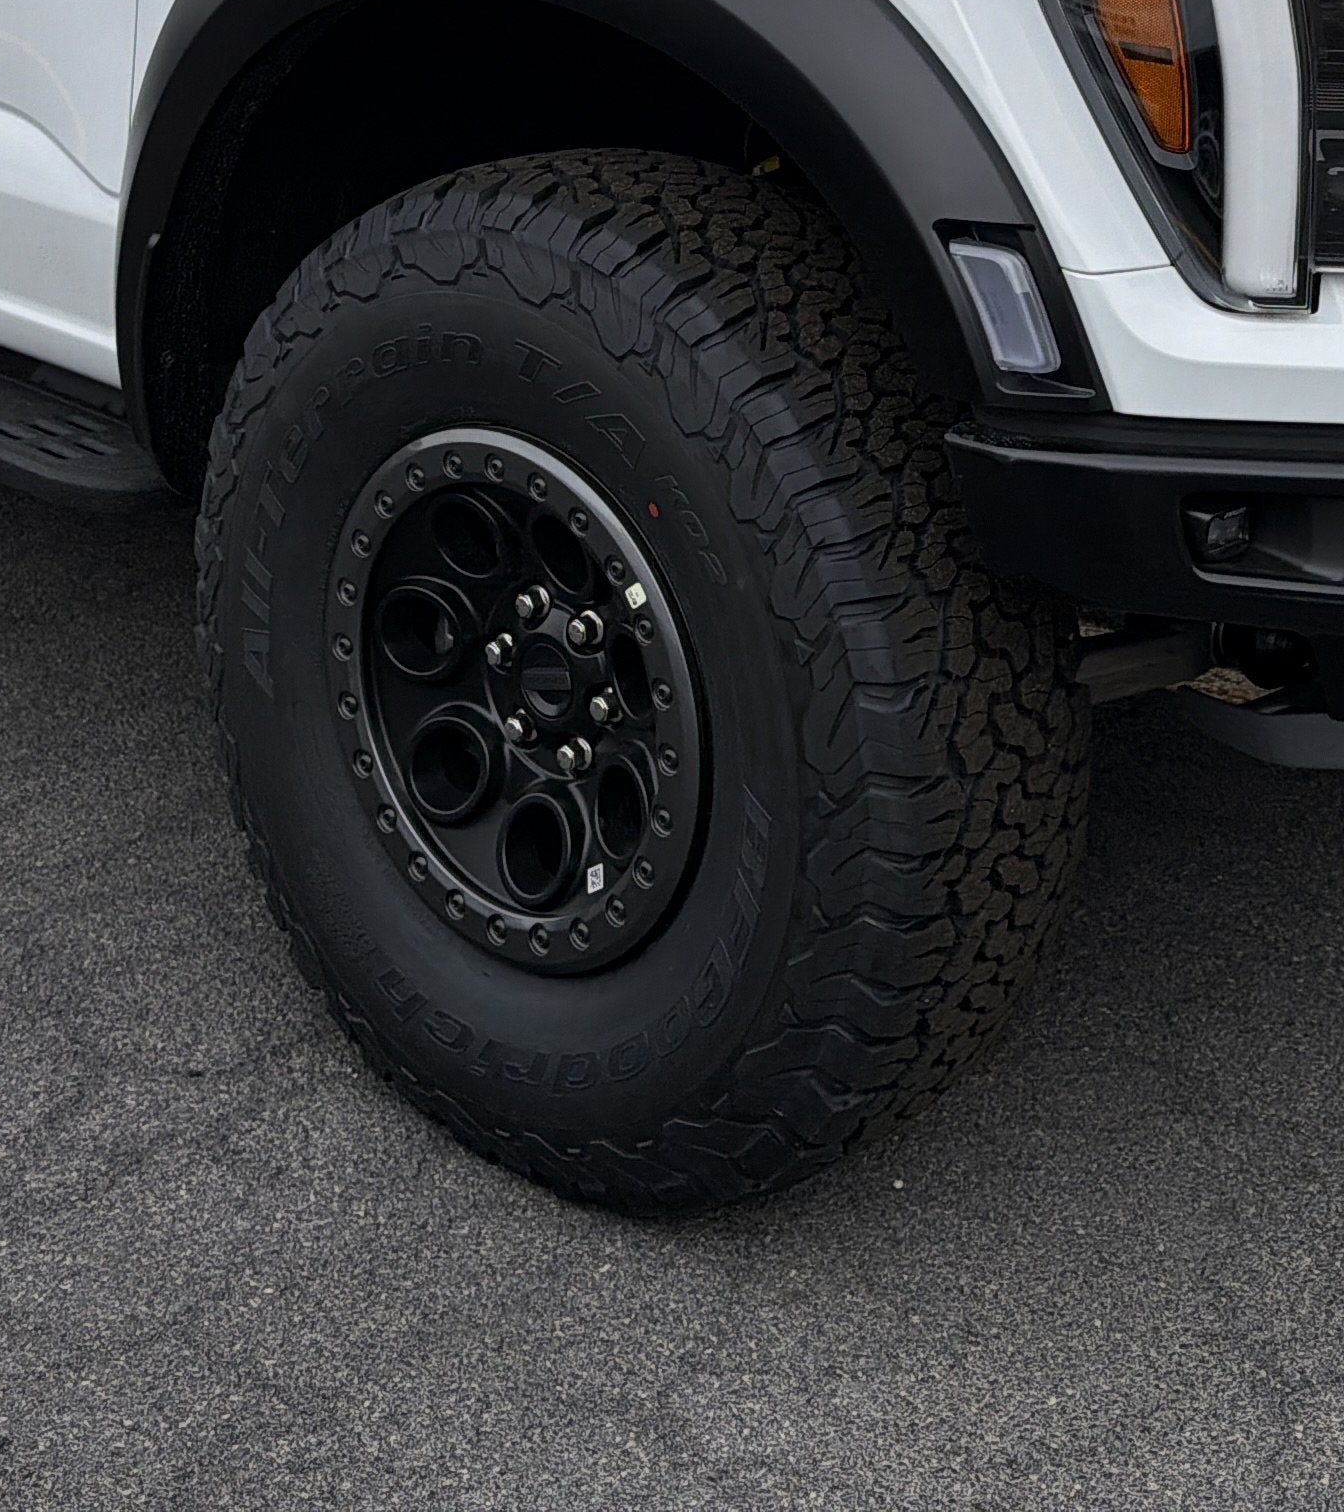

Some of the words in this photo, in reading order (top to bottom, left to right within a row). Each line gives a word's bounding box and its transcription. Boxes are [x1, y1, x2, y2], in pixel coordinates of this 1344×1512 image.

[238, 322, 484, 700] All-Terrain
[513, 337, 648, 470] T/A
[374, 782, 774, 1096] BFGoodrich
